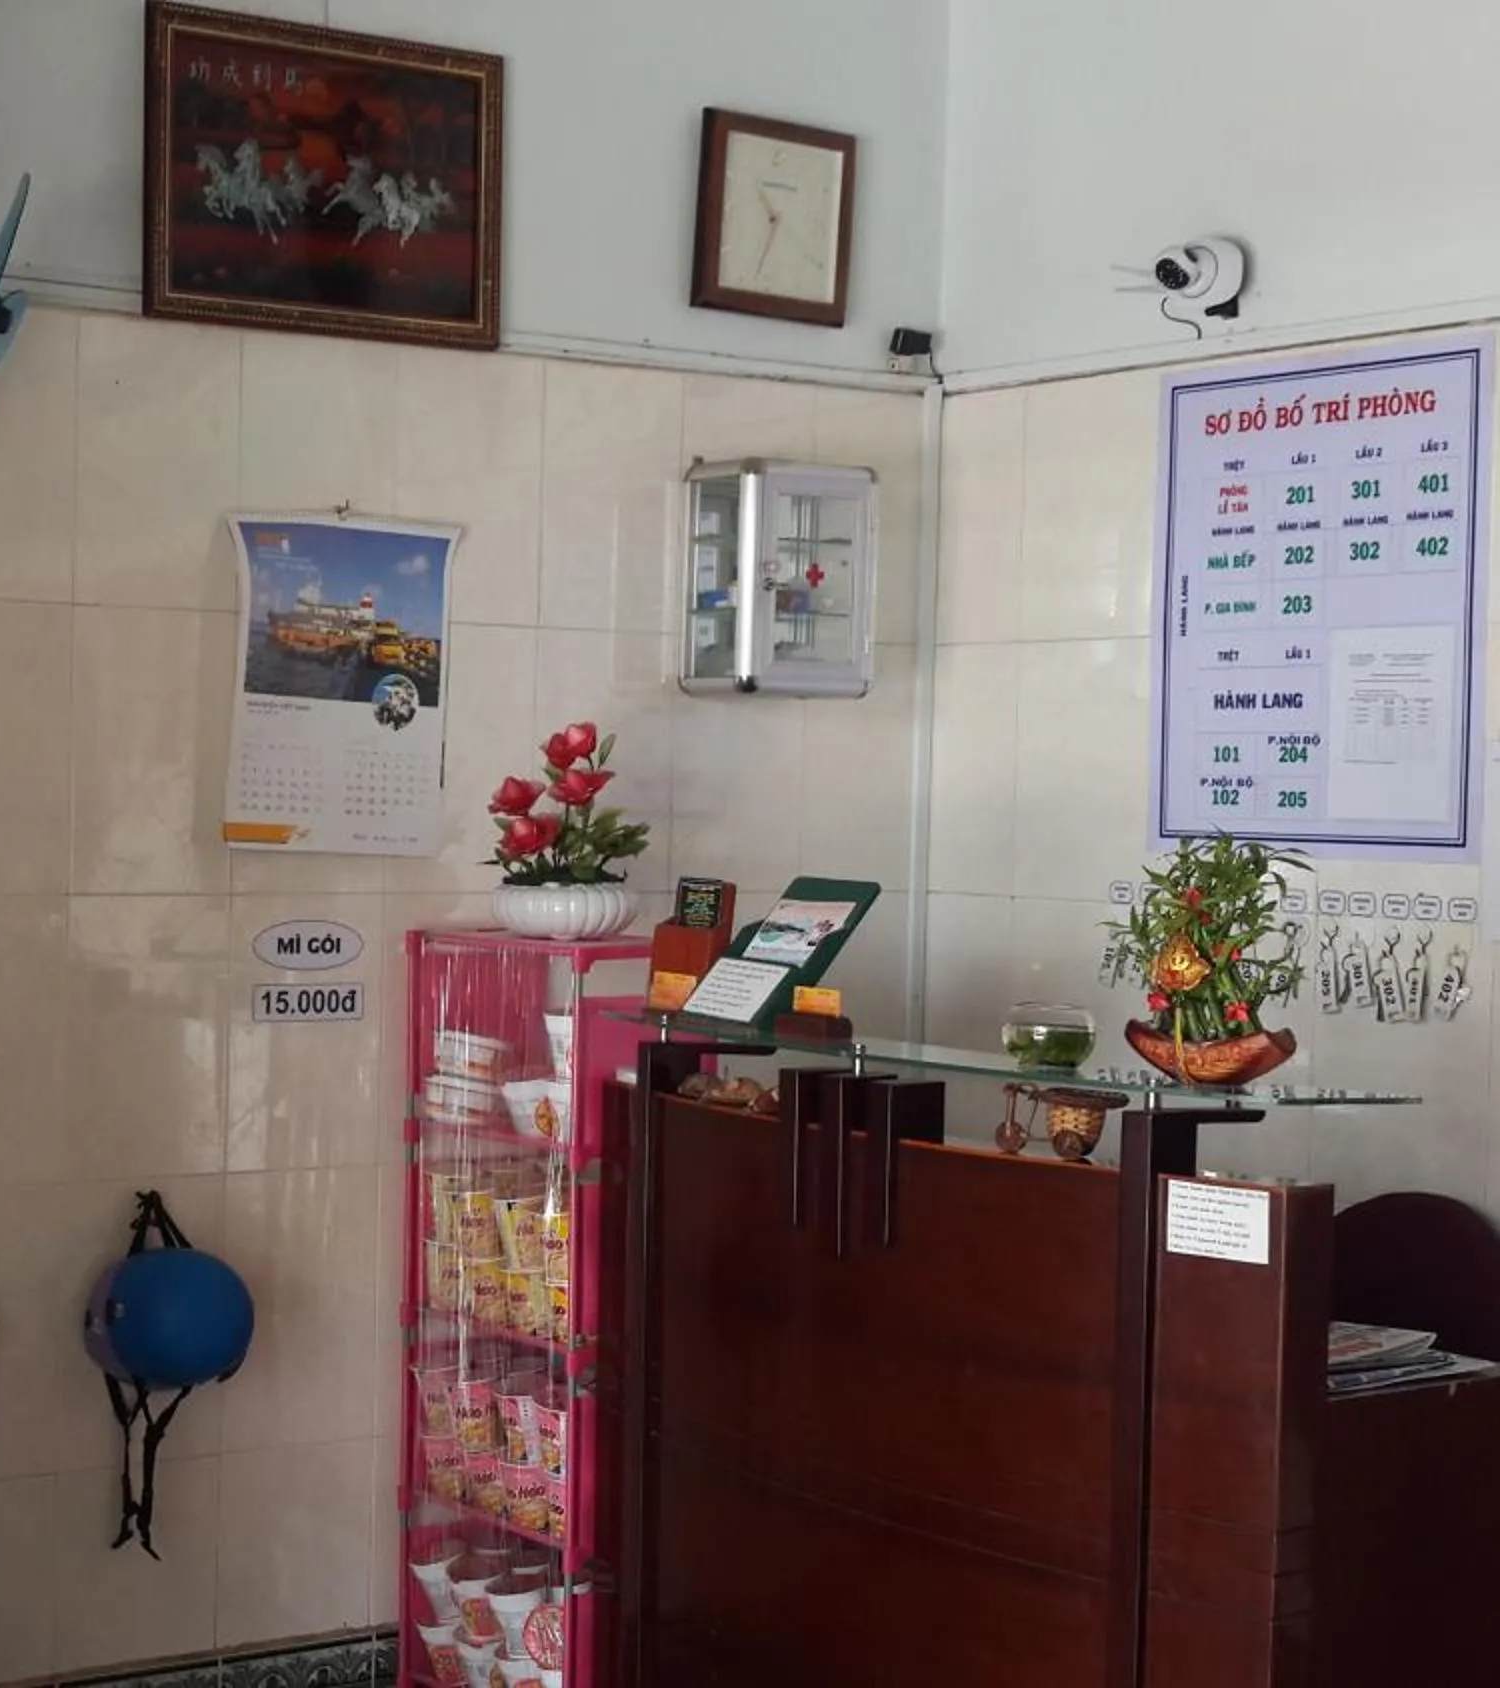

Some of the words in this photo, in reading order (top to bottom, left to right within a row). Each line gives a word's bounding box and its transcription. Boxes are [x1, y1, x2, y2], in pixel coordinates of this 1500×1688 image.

[1205, 410, 1232, 436] SƠ
[1238, 397, 1267, 432] ĐỒ
[1275, 394, 1307, 429] BỐ
[1312, 394, 1350, 424] TRÍ
[1357, 388, 1436, 420] PHÒNG
[1351, 480, 1381, 500] 301
[1417, 474, 1449, 494] 401
[1285, 485, 1314, 505] 201
[1284, 546, 1314, 564] 202
[1349, 541, 1380, 561] 302
[1416, 536, 1449, 556] 402
[1282, 595, 1312, 615] 203
[1214, 690, 1256, 709] HÀNH
[1262, 693, 1303, 709] LANG
[1213, 746, 1240, 763] 101
[1278, 746, 1308, 763] 204
[1211, 789, 1239, 805] 102
[1277, 791, 1307, 808] 205
[277, 933, 301, 955] MÌ
[307, 933, 341, 954] GÓI
[1352, 963, 1364, 987] 301
[1381, 978, 1397, 1005] 302
[1437, 974, 1455, 1003] 402
[261, 989, 357, 1015] 15.000đ
